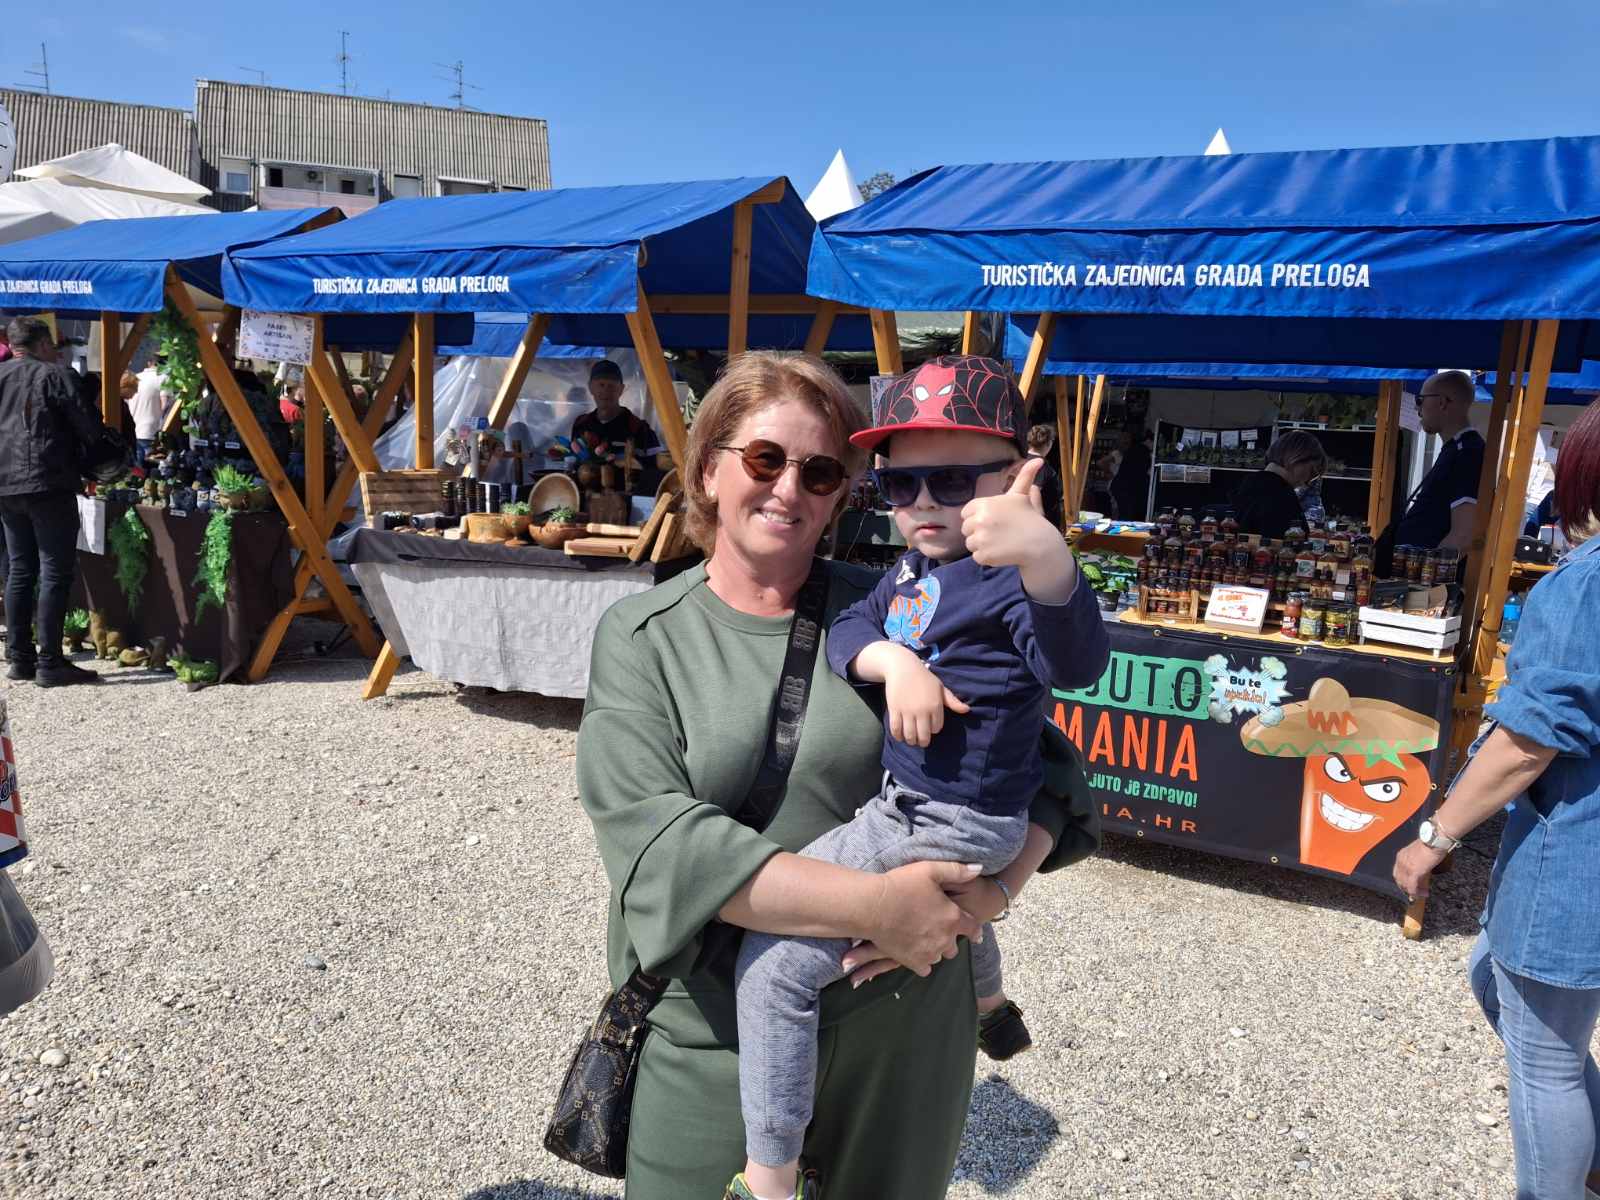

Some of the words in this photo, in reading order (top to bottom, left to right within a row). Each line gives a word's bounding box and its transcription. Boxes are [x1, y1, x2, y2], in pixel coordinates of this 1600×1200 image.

[981, 262, 1076, 286] TURISTIČKA
[1084, 264, 1185, 287] ZAJEDNICA
[1195, 264, 1262, 287] GRADA
[1271, 263, 1370, 288] PRELOGA
[40, 280, 62, 294] GRADA
[62, 280, 93, 294] PRELOGA
[313, 277, 363, 294] TURISTIČKA
[366, 278, 418, 294] ZAJEDNICA
[422, 277, 457, 293] GRADA
[460, 276, 510, 293] PRELOGA
[1062, 657, 1202, 712] UTO
[1230, 676, 1245, 685] Bu
[1249, 679, 1261, 688] te
[1053, 702, 1198, 781] MANIA
[1124, 779, 1140, 796] je
